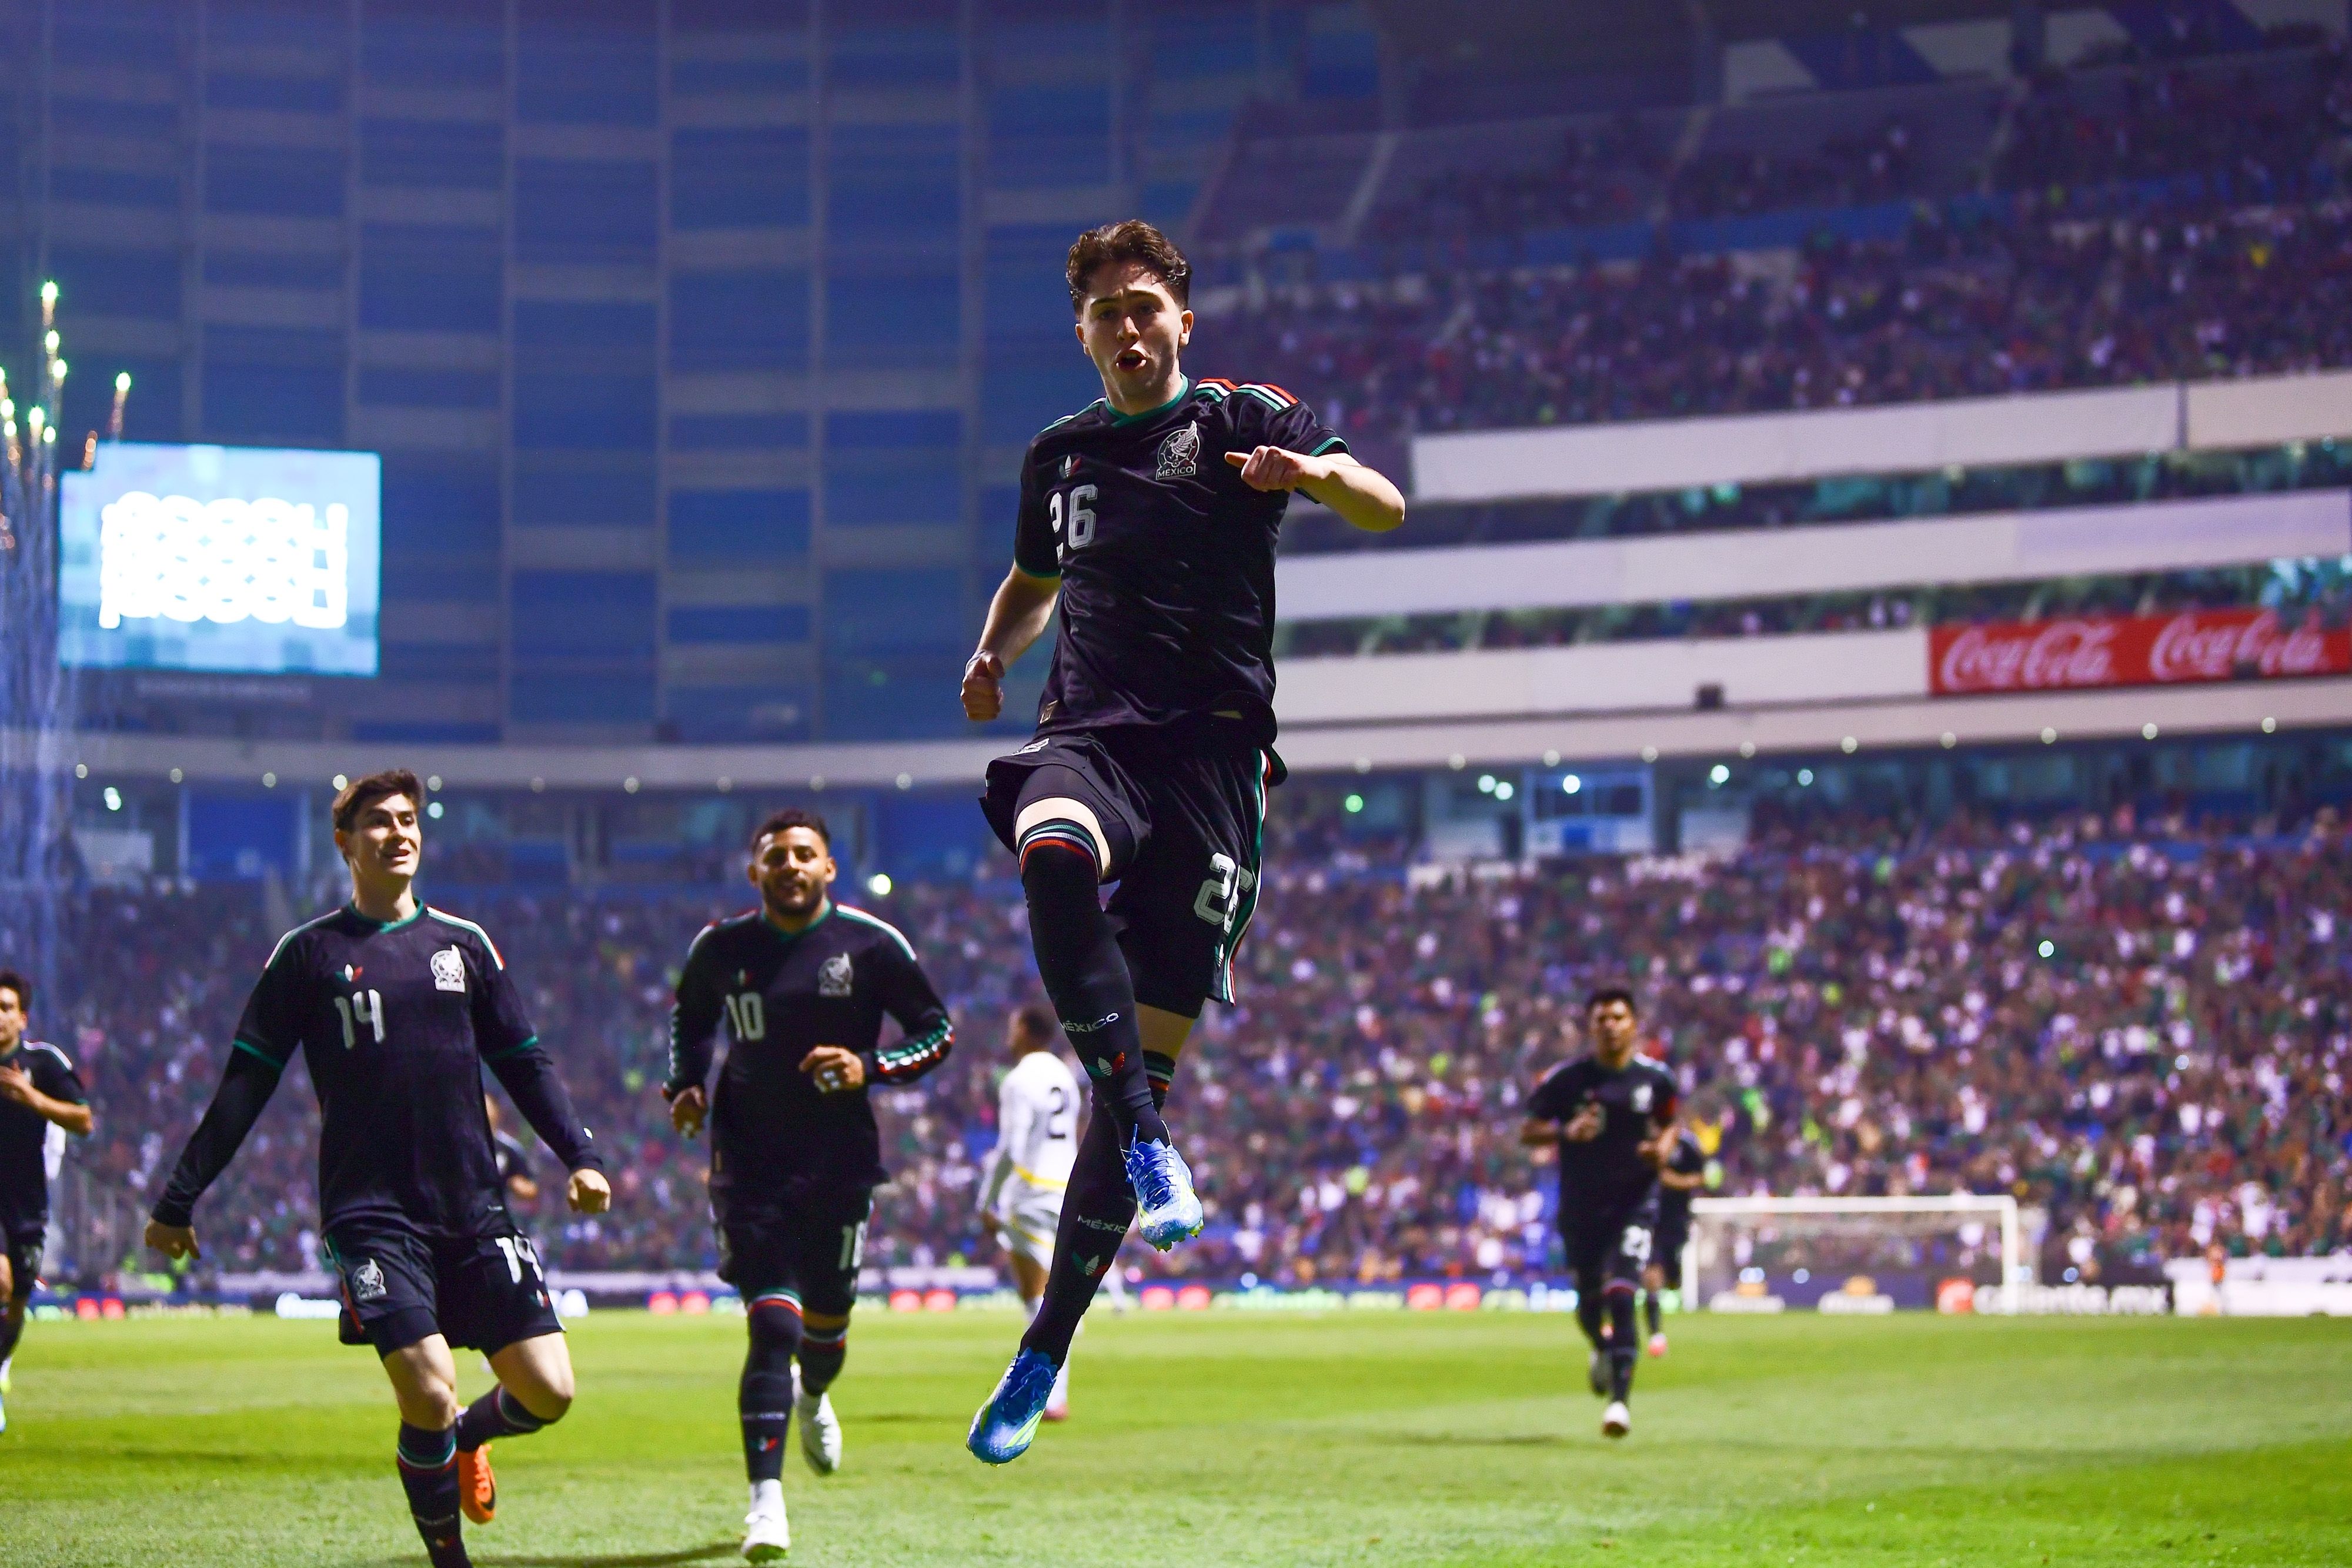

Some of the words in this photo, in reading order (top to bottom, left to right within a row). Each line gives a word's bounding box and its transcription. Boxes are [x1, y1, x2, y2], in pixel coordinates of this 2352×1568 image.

[334, 989, 386, 1049] 14
[725, 991, 764, 1041] 10
[1047, 1086, 1067, 1139] 2
